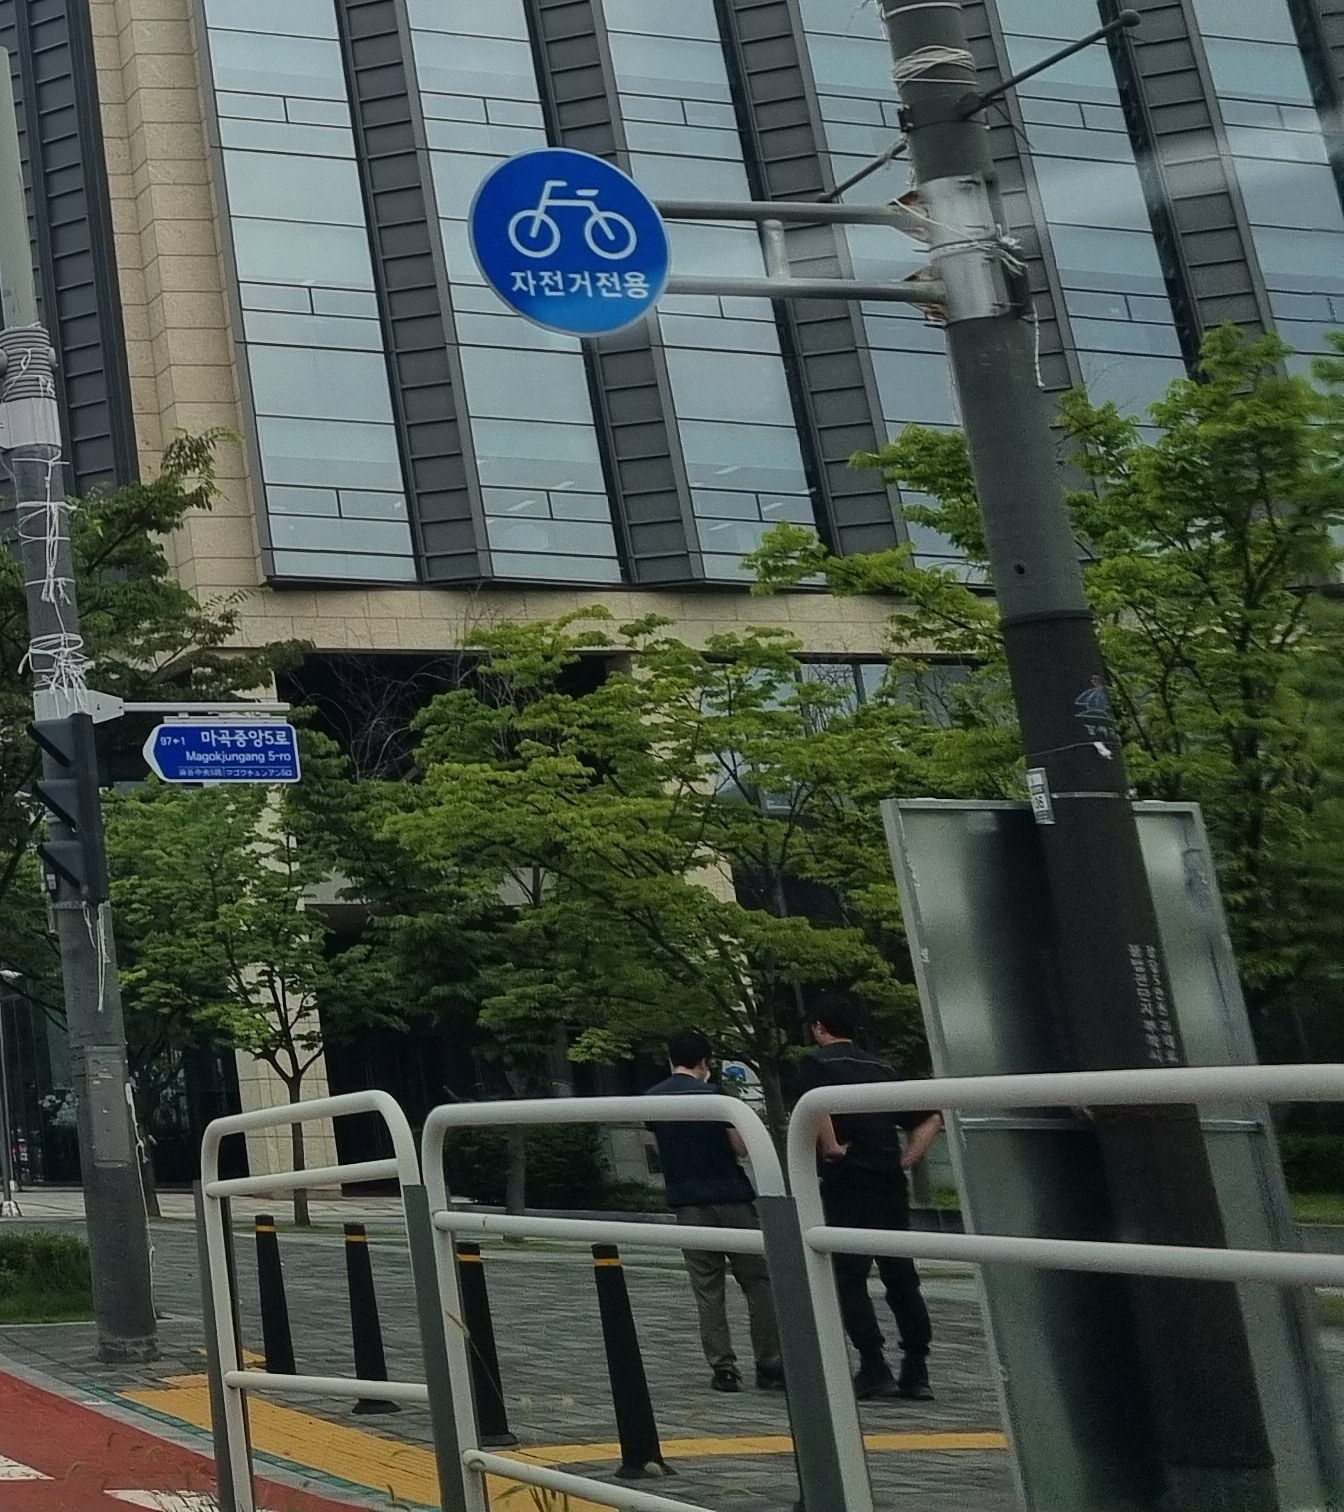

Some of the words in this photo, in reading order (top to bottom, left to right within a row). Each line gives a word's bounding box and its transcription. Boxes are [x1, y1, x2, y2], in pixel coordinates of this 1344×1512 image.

[509, 269, 651, 300] 자전거전용
[200, 729, 291, 748] 마곡중앙5로
[185, 750, 266, 764] Magokjungang
[268, 751, 292, 762] 5-ro
